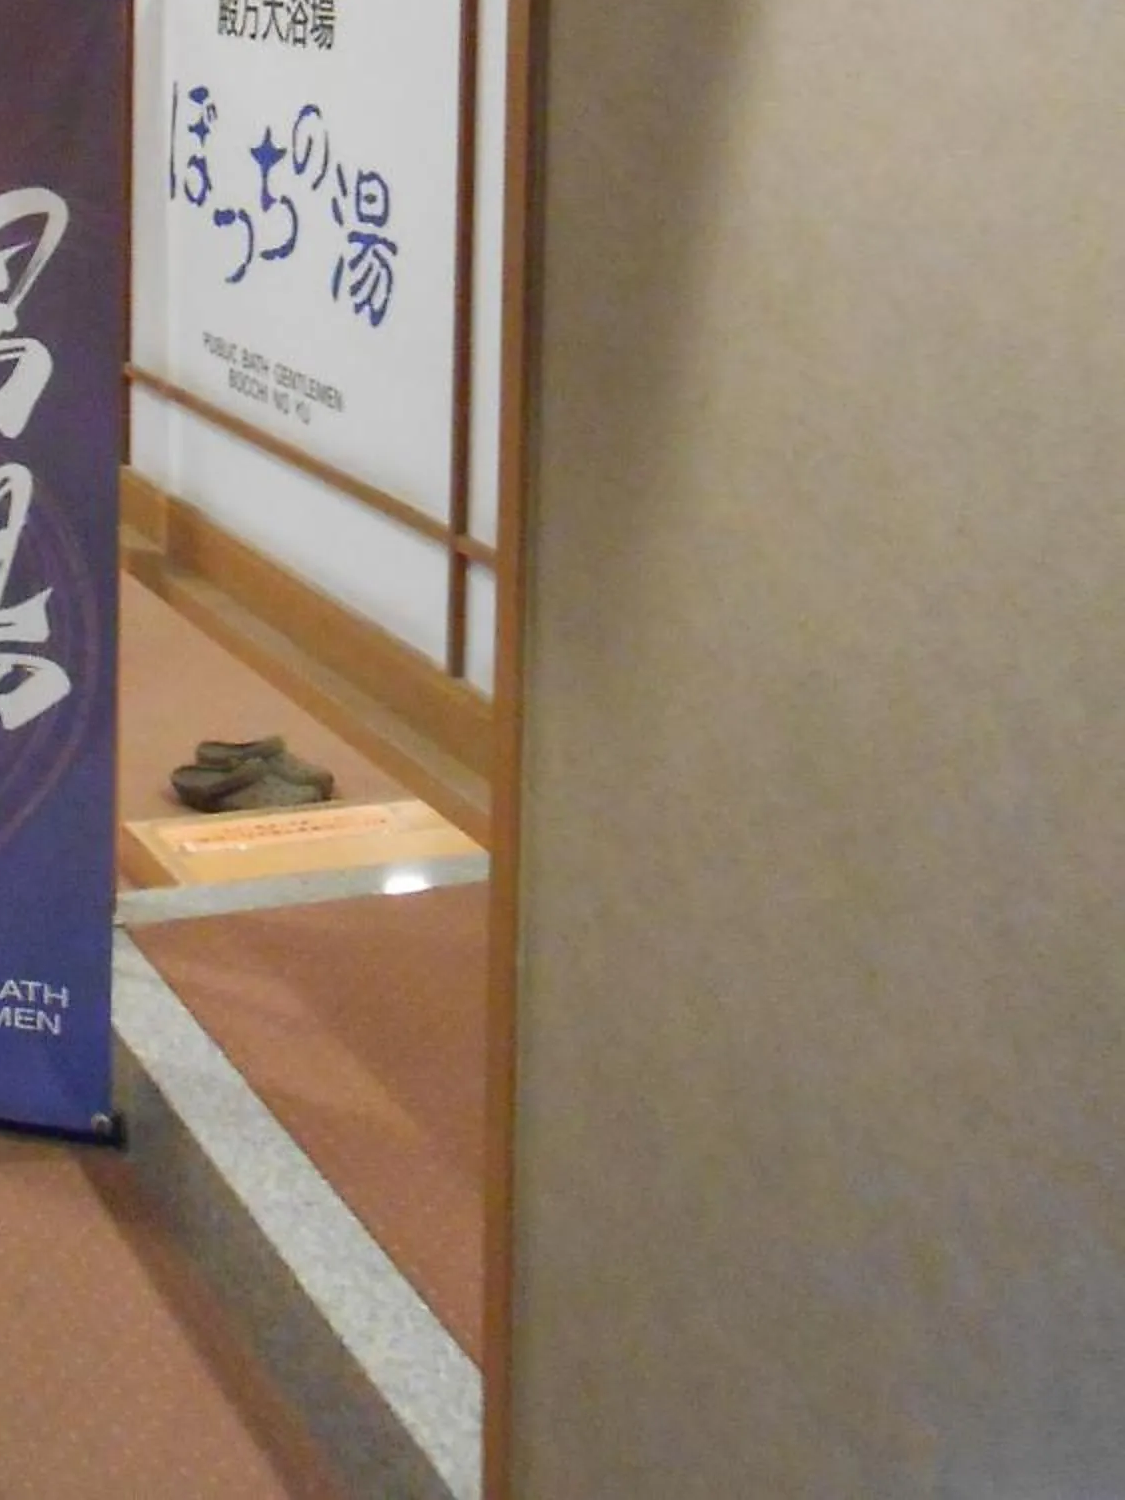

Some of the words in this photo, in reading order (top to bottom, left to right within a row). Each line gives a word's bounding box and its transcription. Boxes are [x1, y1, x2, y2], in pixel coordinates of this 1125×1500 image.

[203, 331, 237, 364] PUBLIC
[242, 348, 270, 376] BATH
[275, 362, 344, 412] GENTLEMEN
